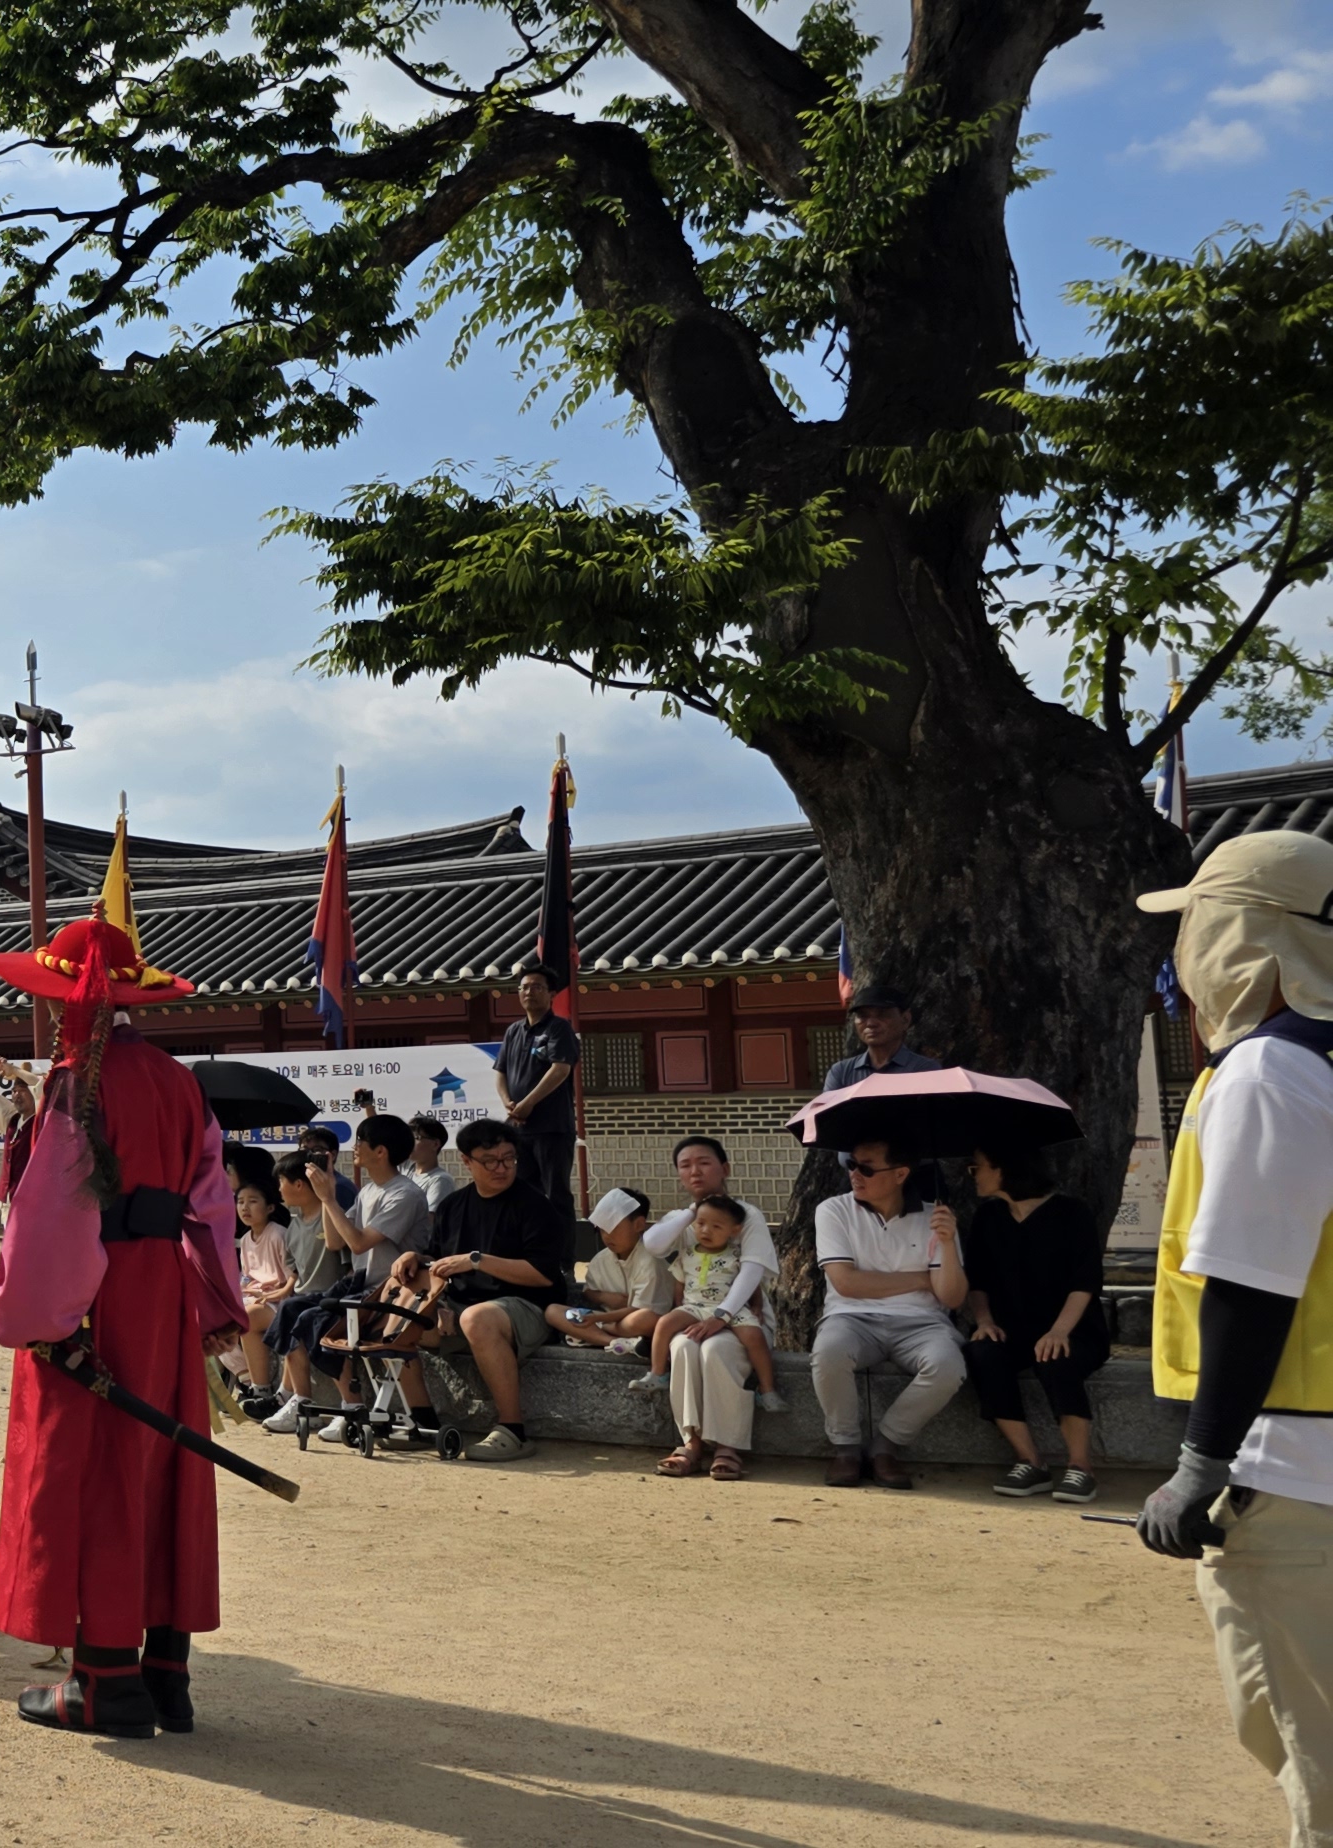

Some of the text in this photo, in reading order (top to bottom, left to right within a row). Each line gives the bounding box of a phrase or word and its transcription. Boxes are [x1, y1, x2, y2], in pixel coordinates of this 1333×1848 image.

[307, 1064, 329, 1079] 매주
[331, 1063, 364, 1077] 토요일
[368, 1061, 401, 1075] 16:00
